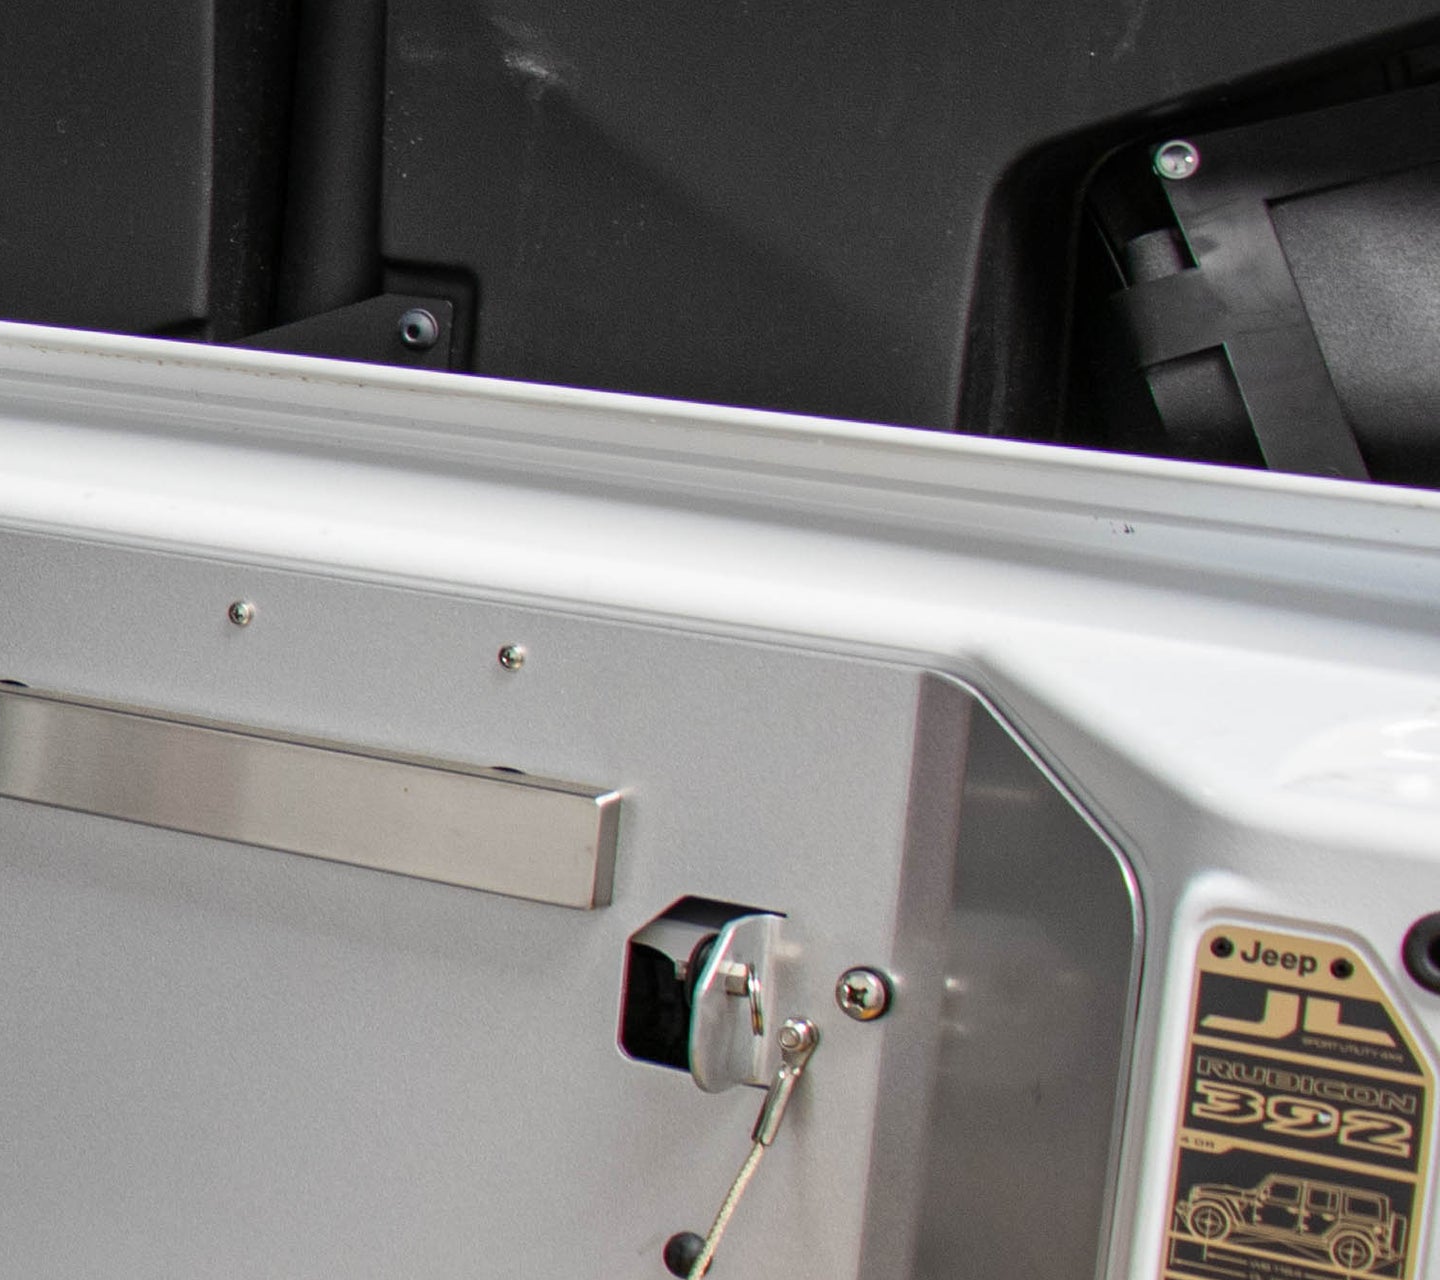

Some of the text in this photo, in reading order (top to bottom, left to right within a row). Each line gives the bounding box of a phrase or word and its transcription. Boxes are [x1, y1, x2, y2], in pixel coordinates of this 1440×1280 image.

[1241, 940, 1318, 976] Jeep
[1200, 989, 1396, 1047] JL
[1197, 1056, 1416, 1114] RUBICON
[1192, 1080, 1413, 1158] 392
